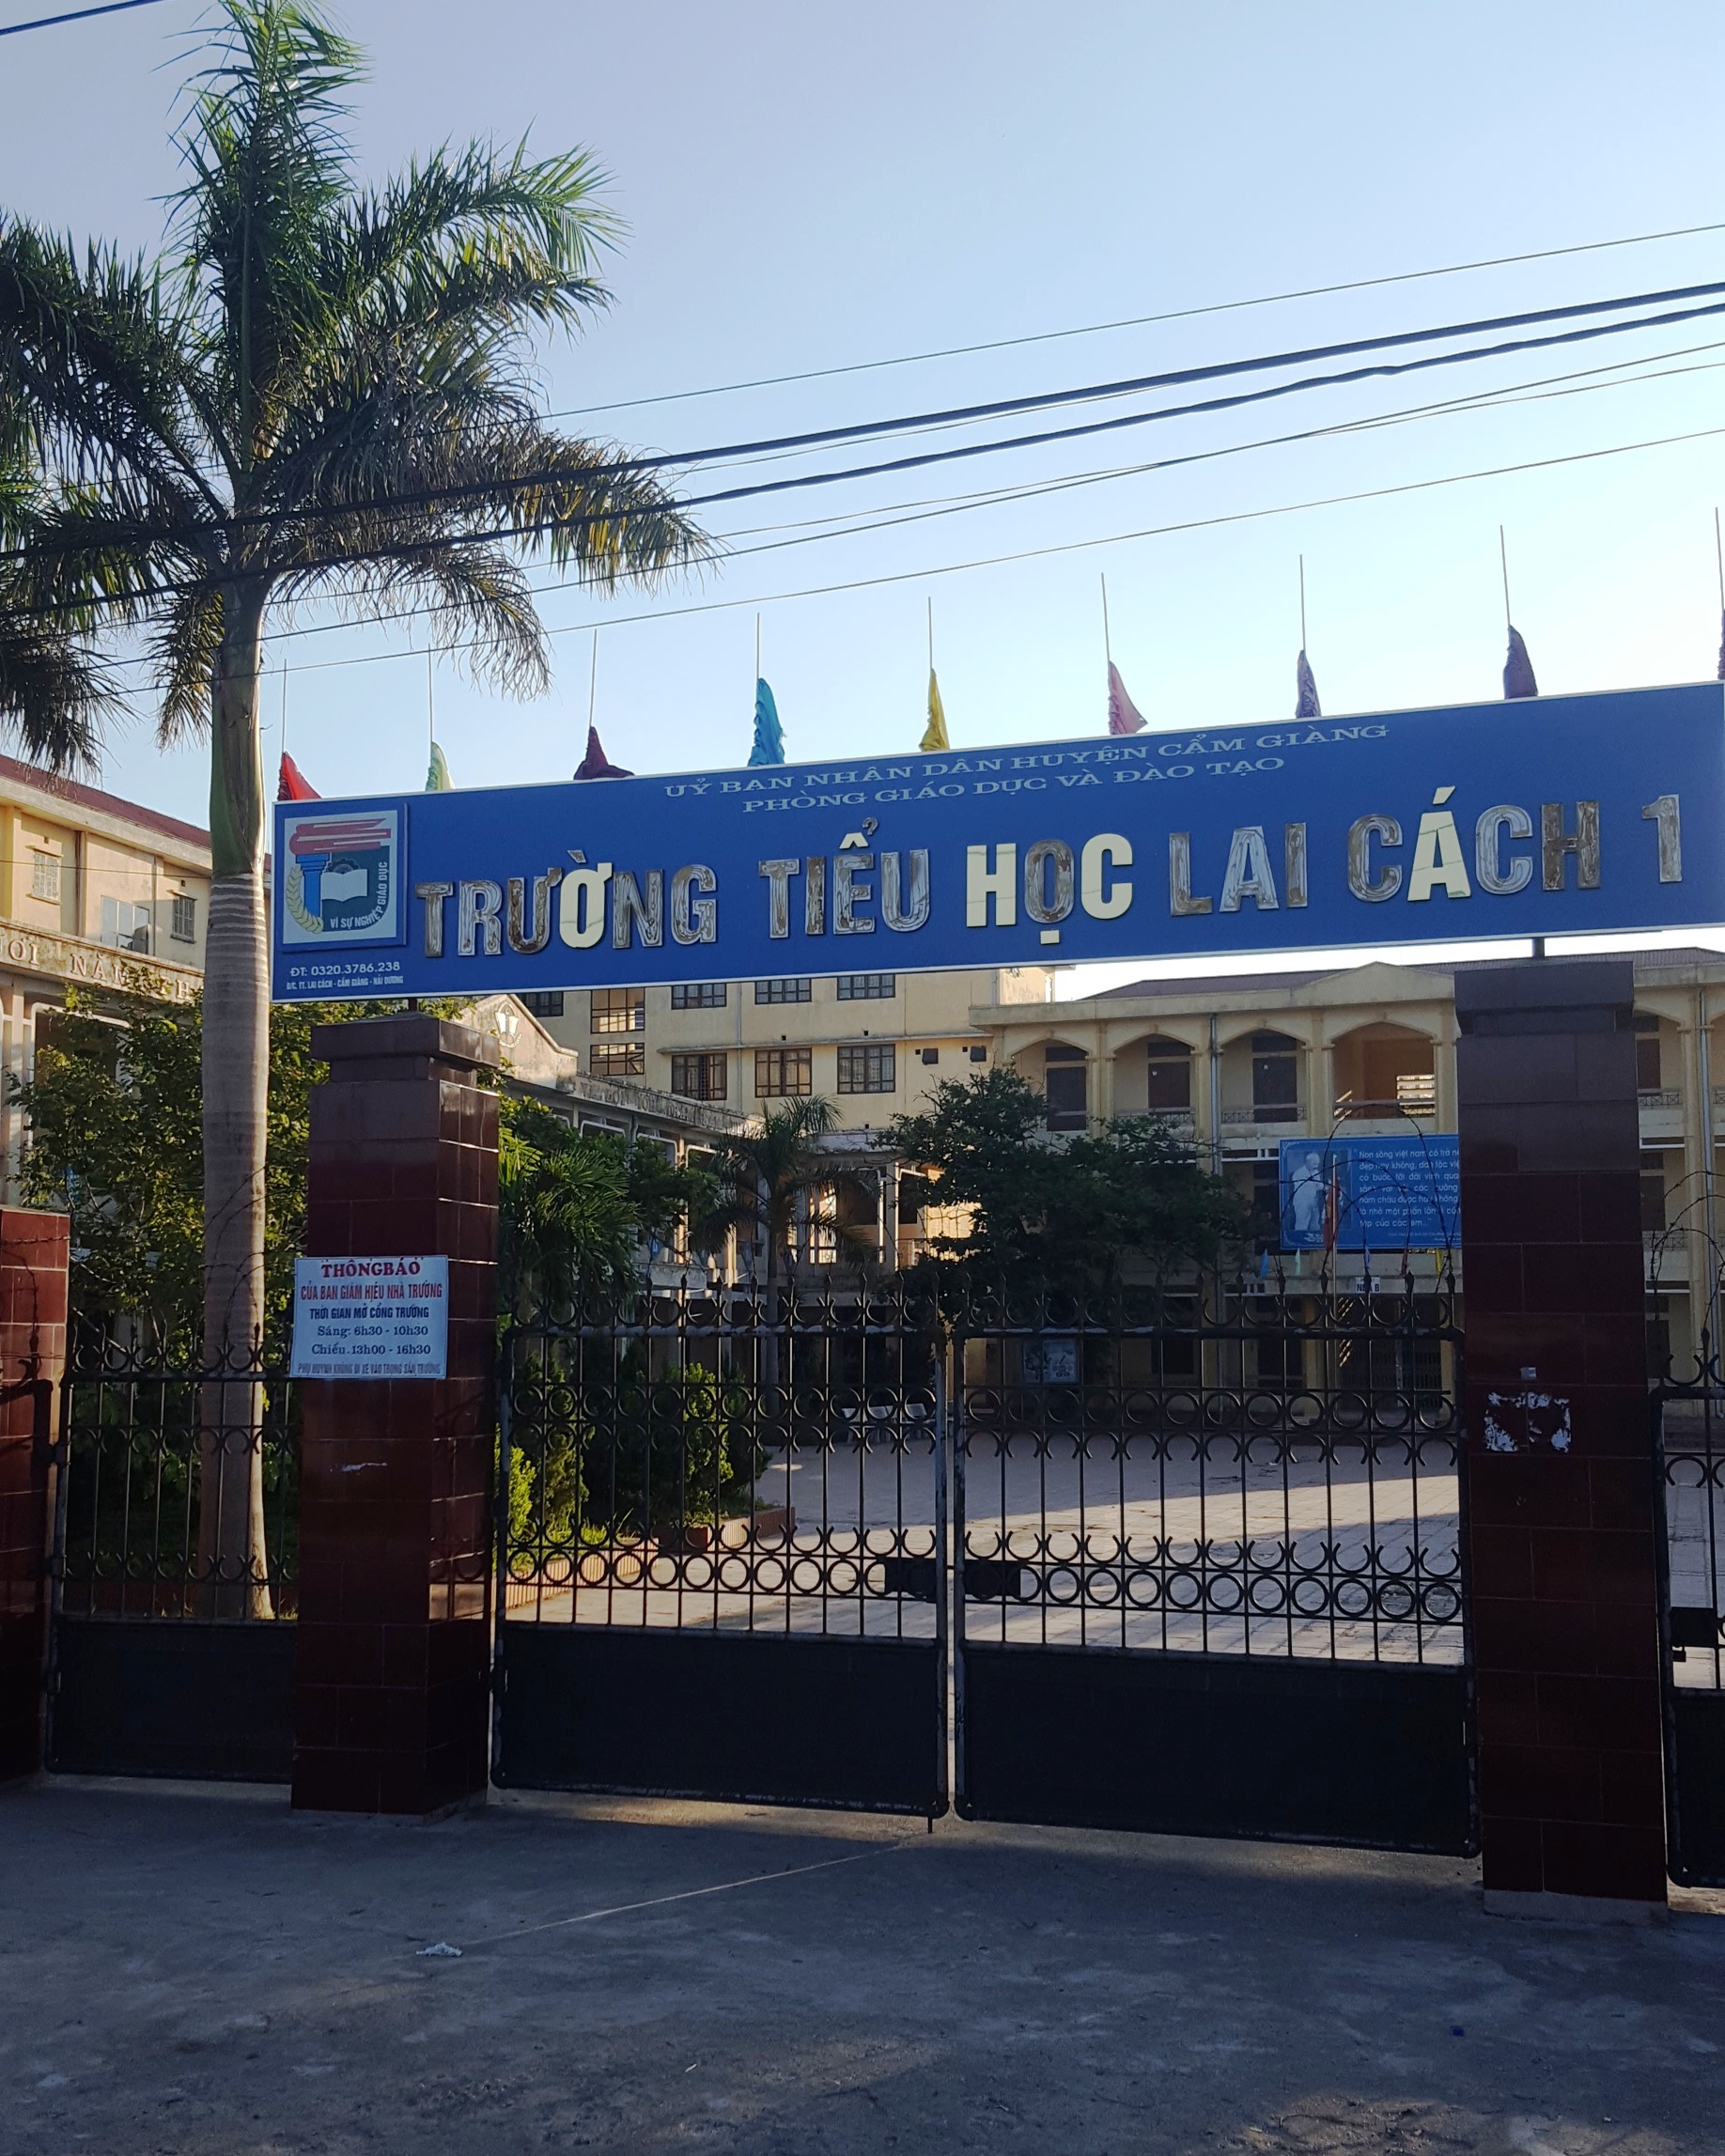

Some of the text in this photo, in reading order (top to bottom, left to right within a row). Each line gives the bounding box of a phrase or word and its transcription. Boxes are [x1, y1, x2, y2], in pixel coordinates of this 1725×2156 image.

[663, 724, 1391, 799] UỶ BAN NHÂN DÂN HUYỆN CẨM GIÀNG
[742, 757, 1284, 813] PHÒNG GIÁO DỤC VÀ ĐÀO TẠO
[415, 786, 1683, 957] TRƯỜNG TIỂU HỌC LAI CÁCH 1
[289, 961, 400, 977] ĐT: 0320.3786.238
[301, 1280, 319, 1300] CỦA
[320, 1285, 338, 1300] BAN
[340, 1281, 363, 1300] GIÁM
[387, 1281, 405, 1299] NHÀ
[331, 1307, 351, 1319] GIAN
[353, 1302, 367, 1319] MỞ
[317, 1324, 350, 1339] Sáng:
[353, 1326, 383, 1336] 6h30
[394, 1325, 428, 1336] 10h30
[351, 1344, 386, 1355] 13h00
[396, 1344, 431, 1355] 16h30
